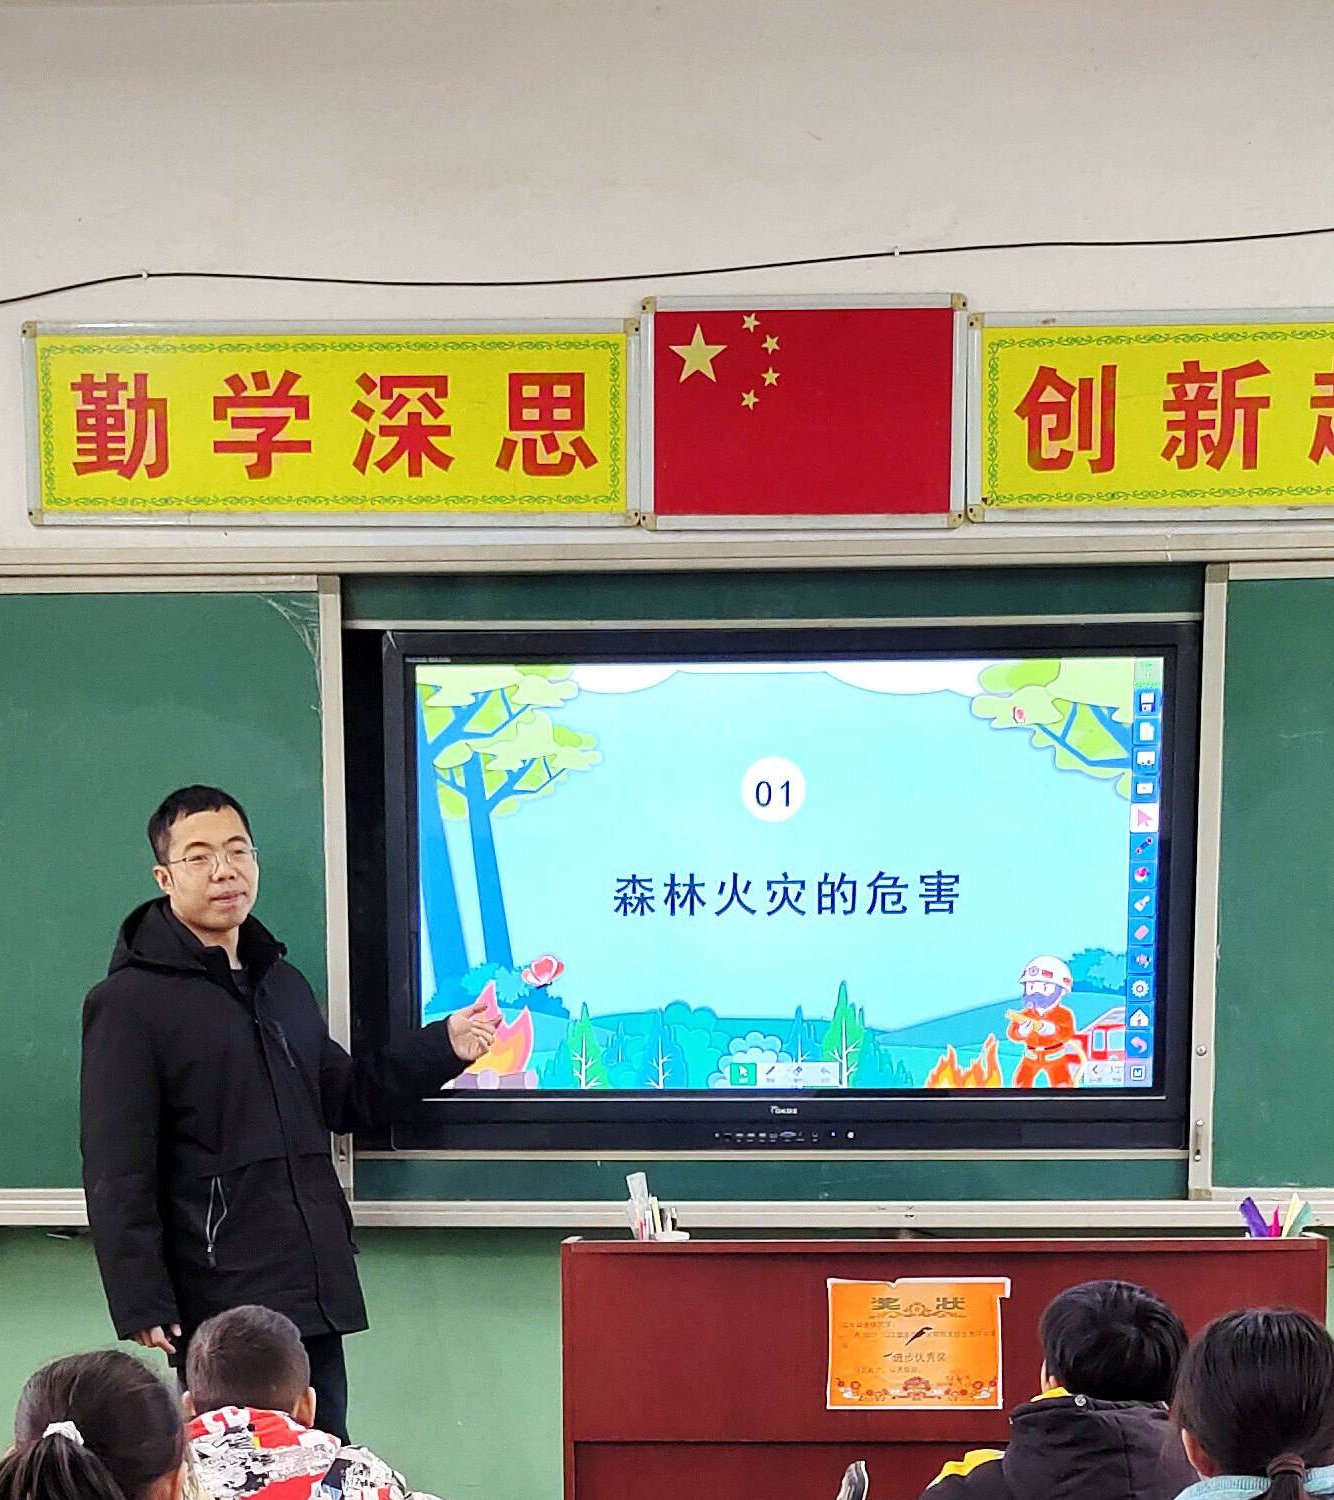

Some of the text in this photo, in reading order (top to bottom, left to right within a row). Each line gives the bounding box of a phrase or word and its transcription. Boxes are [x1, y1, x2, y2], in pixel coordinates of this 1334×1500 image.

[70, 369, 599, 481] 勤学深思
[753, 780, 795, 809] 01
[612, 869, 963, 918] 森林火灾的危害
